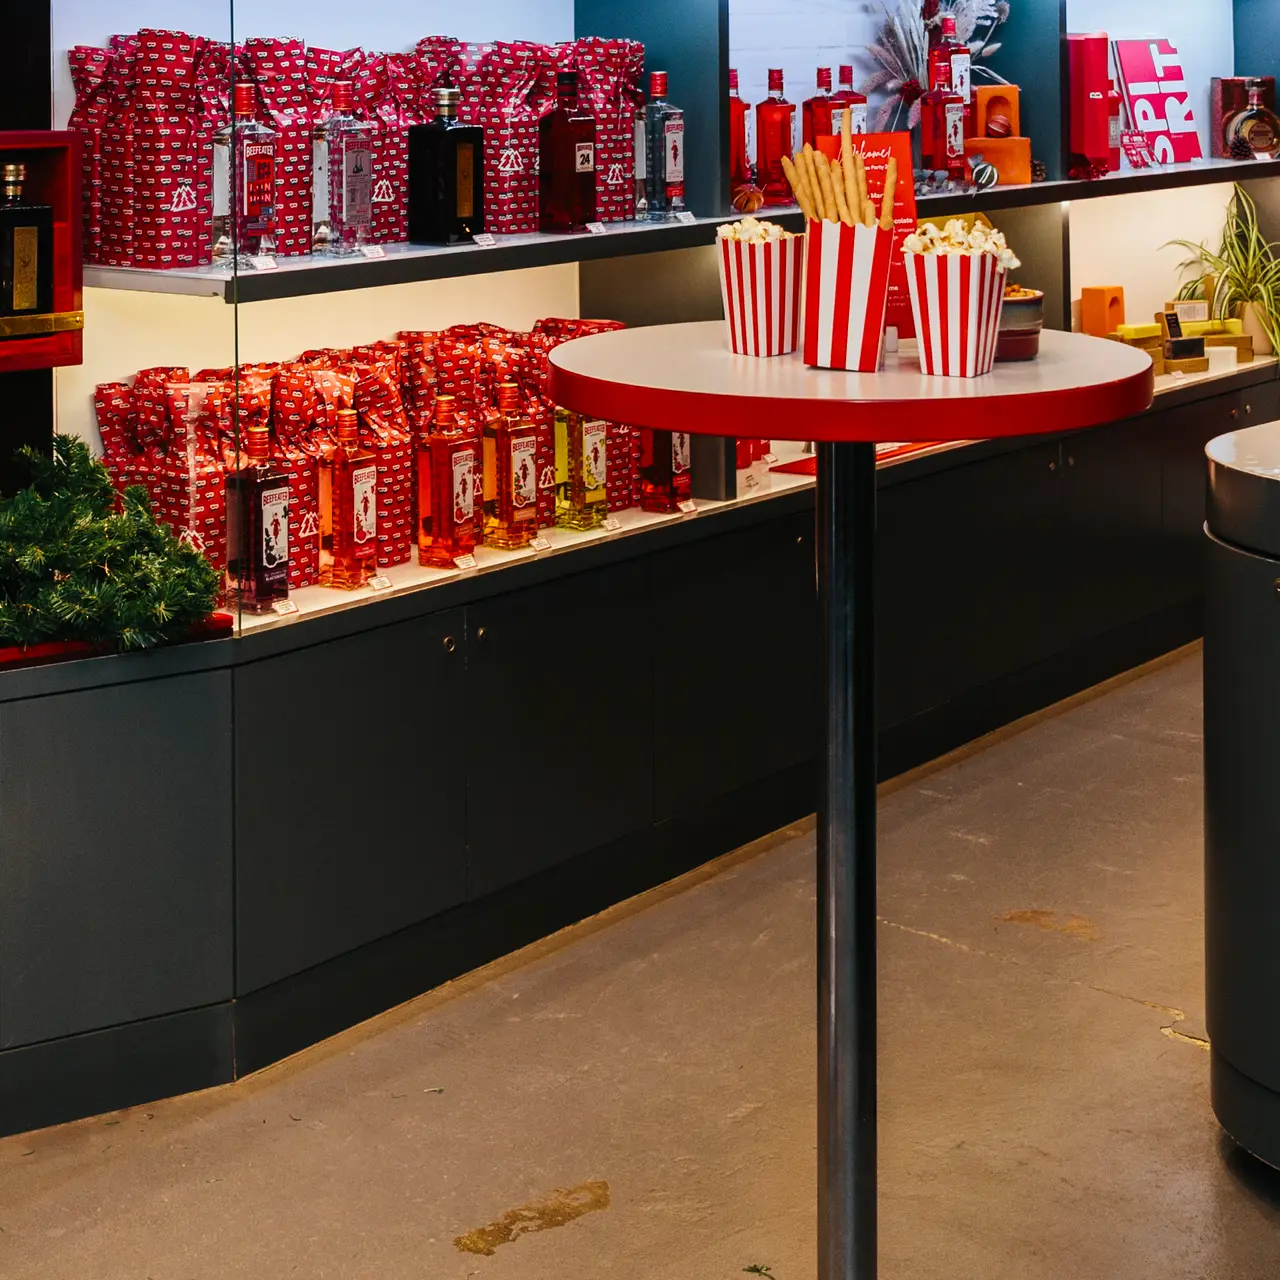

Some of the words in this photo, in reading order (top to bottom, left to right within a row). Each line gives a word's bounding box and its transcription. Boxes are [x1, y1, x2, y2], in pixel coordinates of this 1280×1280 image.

[246, 145, 274, 157] BEEFEATER
[580, 153, 591, 165] 24
[513, 440, 536, 453] BEEFEATER
[263, 491, 288, 507] BEEFEATER
